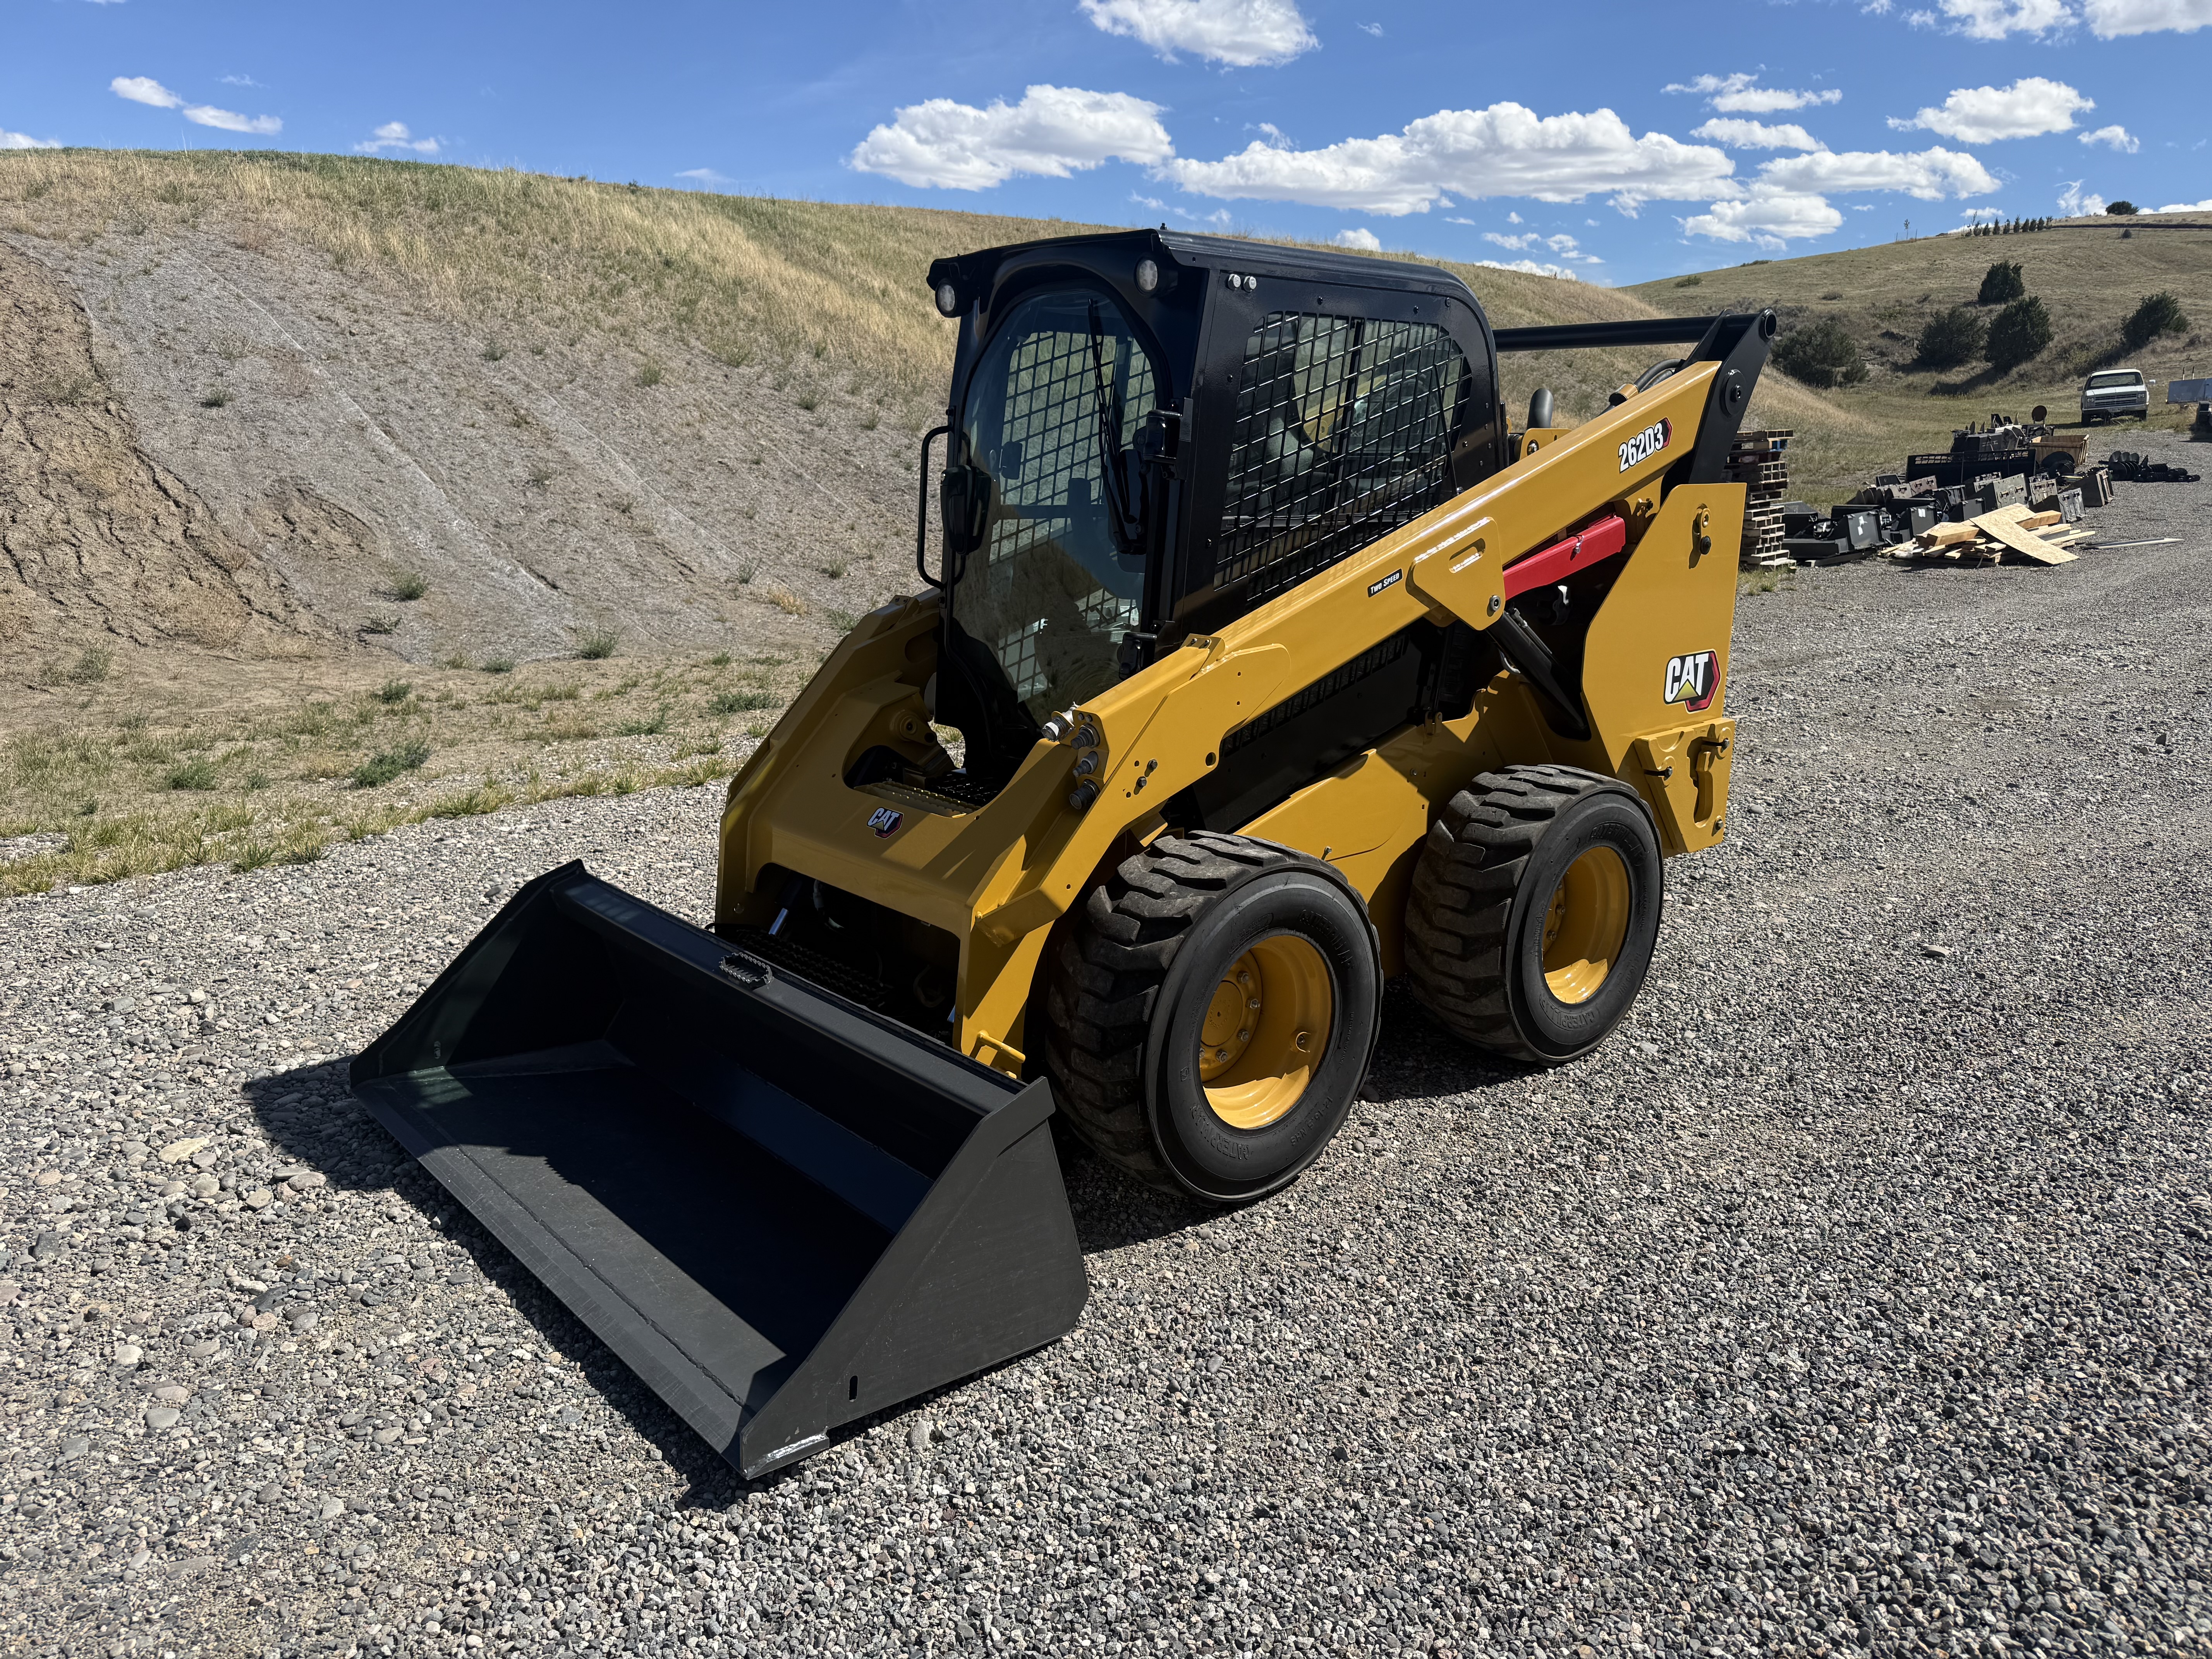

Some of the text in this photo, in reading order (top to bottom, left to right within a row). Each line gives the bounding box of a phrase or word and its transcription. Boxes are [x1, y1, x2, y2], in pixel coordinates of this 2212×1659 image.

[1619, 422, 1664, 472] 262D3
[1665, 653, 1709, 702] CAT
[867, 807, 900, 831] CAT
